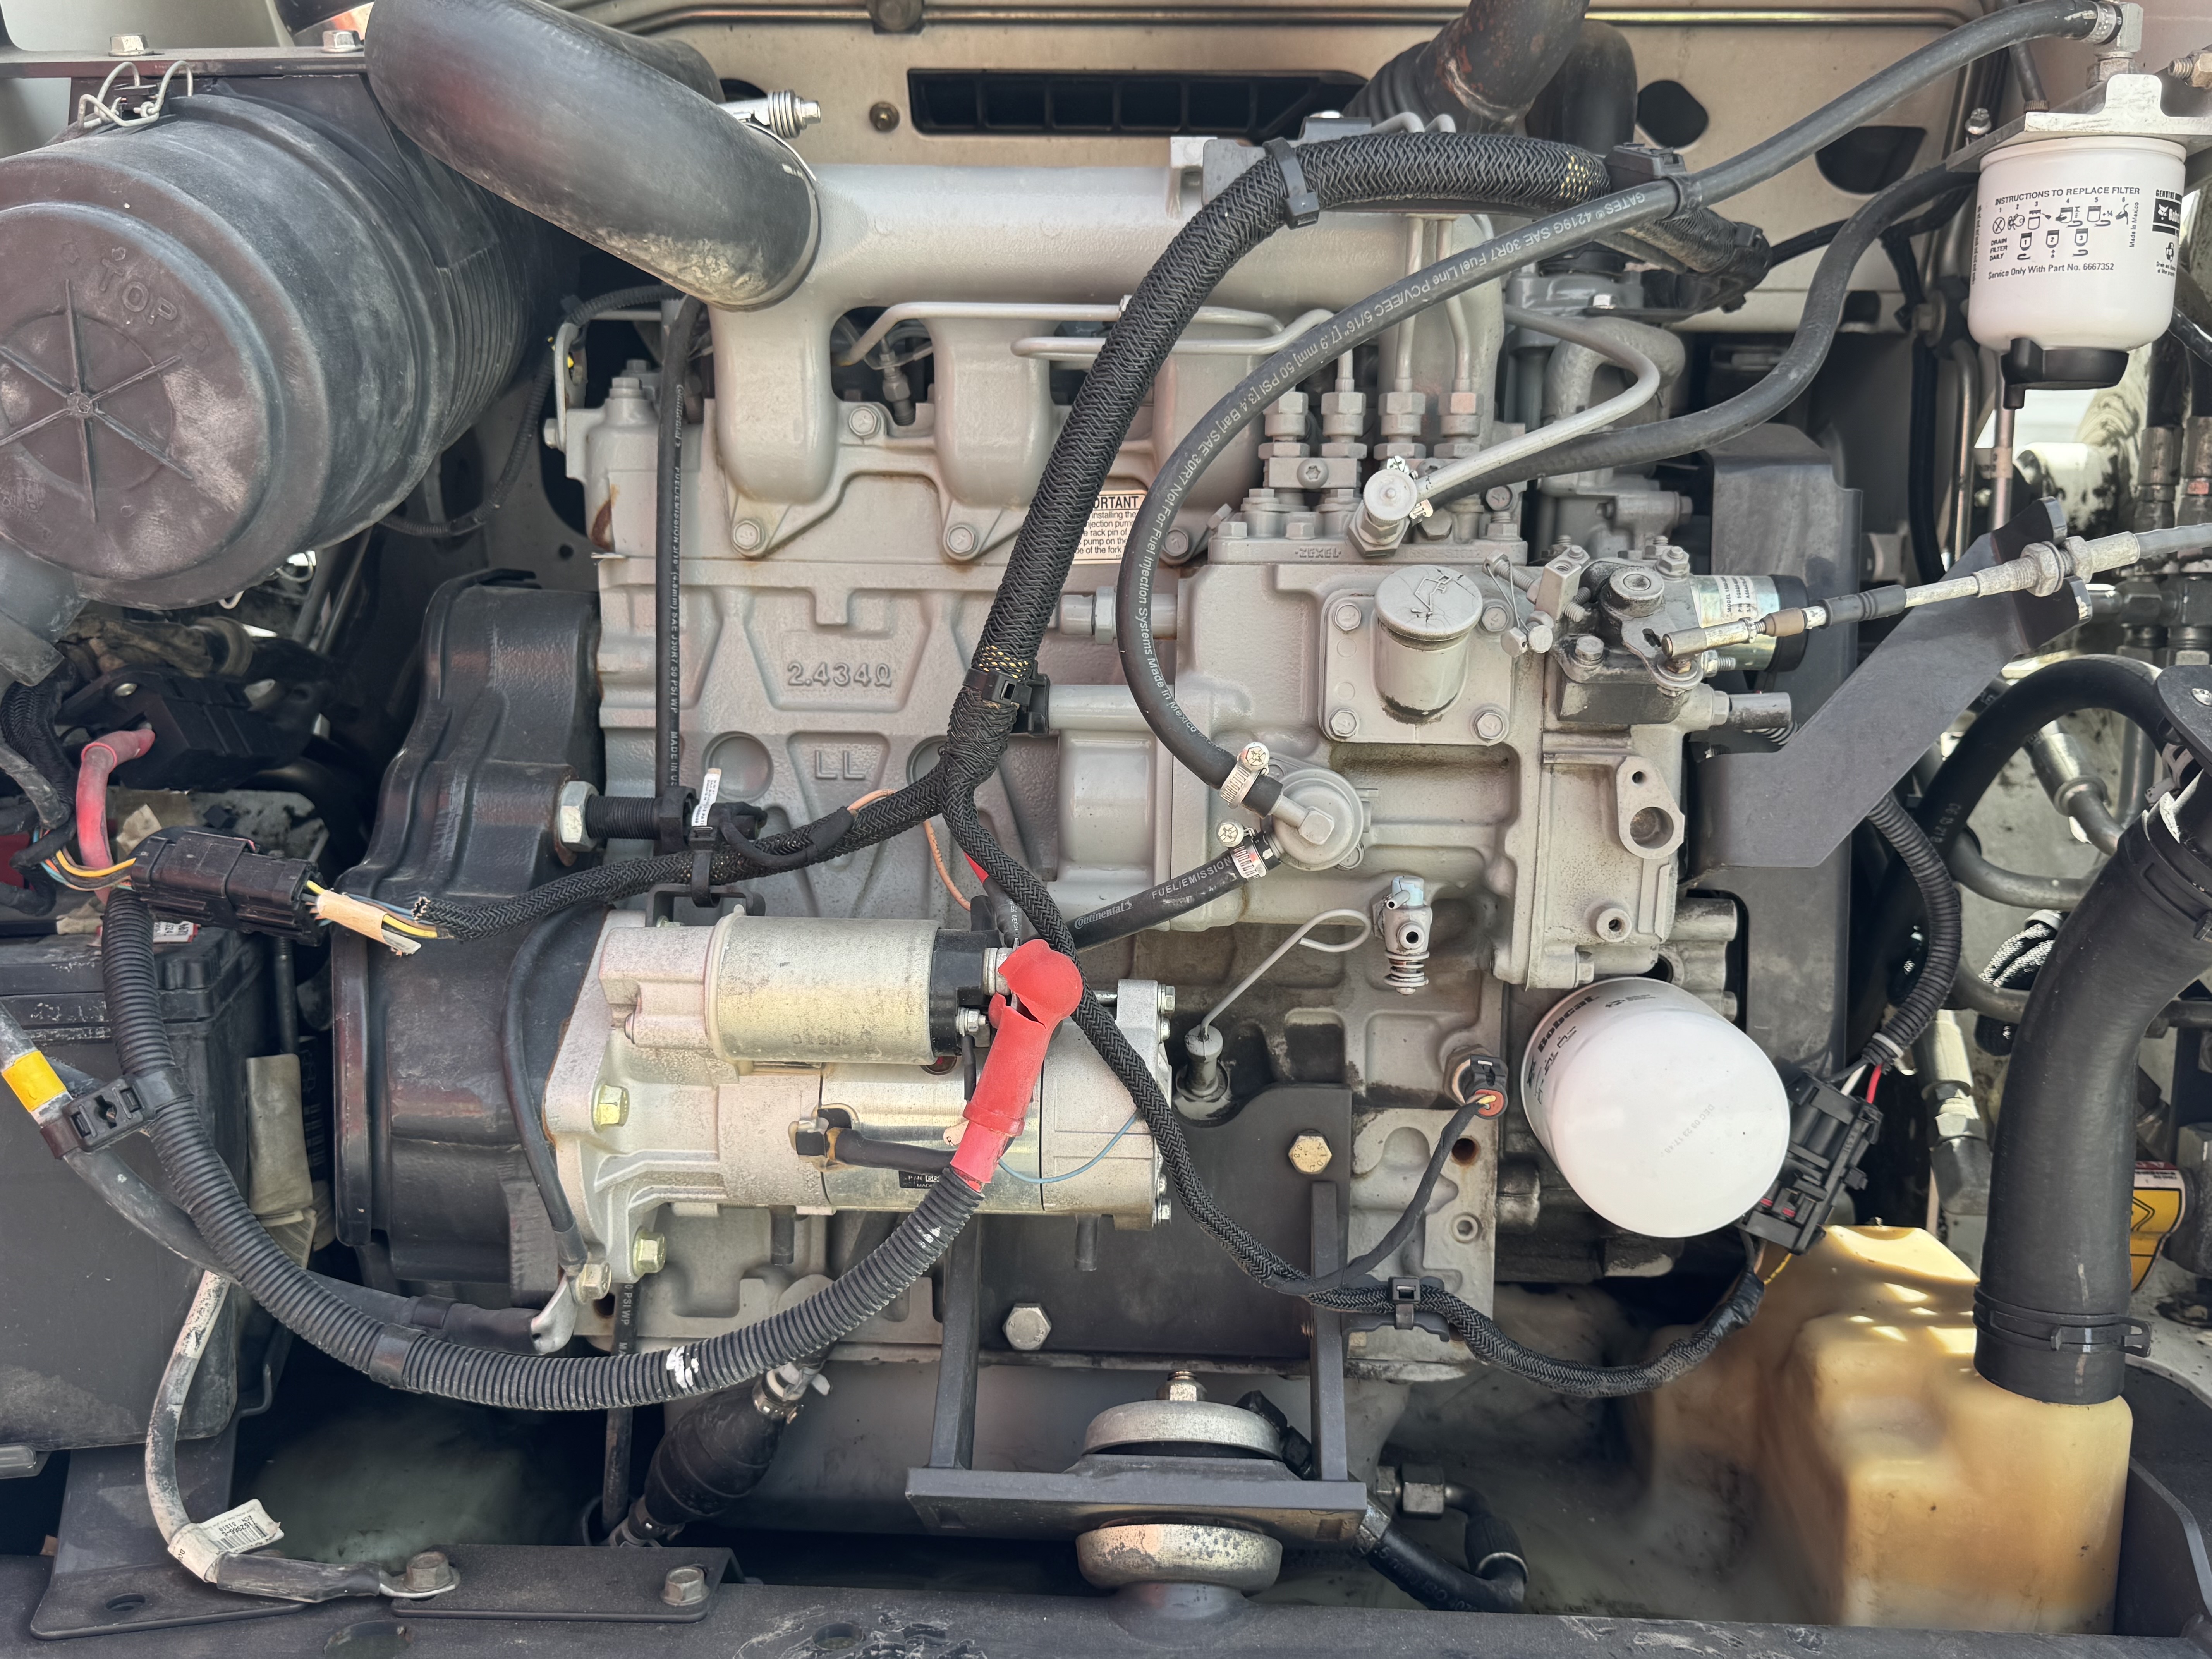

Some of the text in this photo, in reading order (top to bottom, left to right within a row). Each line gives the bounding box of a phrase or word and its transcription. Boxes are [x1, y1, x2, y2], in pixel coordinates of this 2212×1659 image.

[1995, 191, 2049, 205] INSTRUCTIONS
[2066, 187, 2109, 195] REPLACE
[1554, 213, 1592, 234] 4219G
[1523, 228, 1551, 245] SAE
[1491, 242, 1522, 262] 30R7
[1460, 253, 1486, 275] Fuel
[1988, 270, 2009, 280] Service
[2011, 267, 2026, 276] Only
[2028, 265, 2045, 273] With
[1432, 266, 1458, 285] Line
[98, 257, 178, 325] TOP
[1375, 280, 1431, 316] PCV/EEC
[1293, 343, 1319, 367] mm]
[1280, 362, 1295, 378] 50
[1259, 374, 1281, 395] PSI
[1215, 409, 1241, 433] Bar]
[1198, 429, 1220, 457] SAE
[1178, 453, 1201, 486] 30R7
[1094, 496, 1139, 509] ORTANT
[1165, 483, 1183, 507] Not
[1087, 520, 1133, 532] njection pum
[1092, 511, 1123, 521] installing
[1157, 505, 1171, 528] For
[1108, 529, 1119, 539] pin
[1146, 527, 1162, 555] Fuel
[1085, 546, 1093, 554] of
[1108, 545, 1122, 553] fork
[1135, 607, 1153, 655] Systems
[671, 666, 678, 677] 50
[1147, 658, 1165, 688] Made
[671, 696, 678, 714] WP
[1168, 701, 1197, 733] Mexico
[671, 763, 678, 772] IN
[1152, 855, 1232, 900] FUEL/EMISSION
[1699, 1104, 1715, 1120] DEC
[623, 1292, 633, 1307] PSI
[621, 1310, 630, 1325] WP
